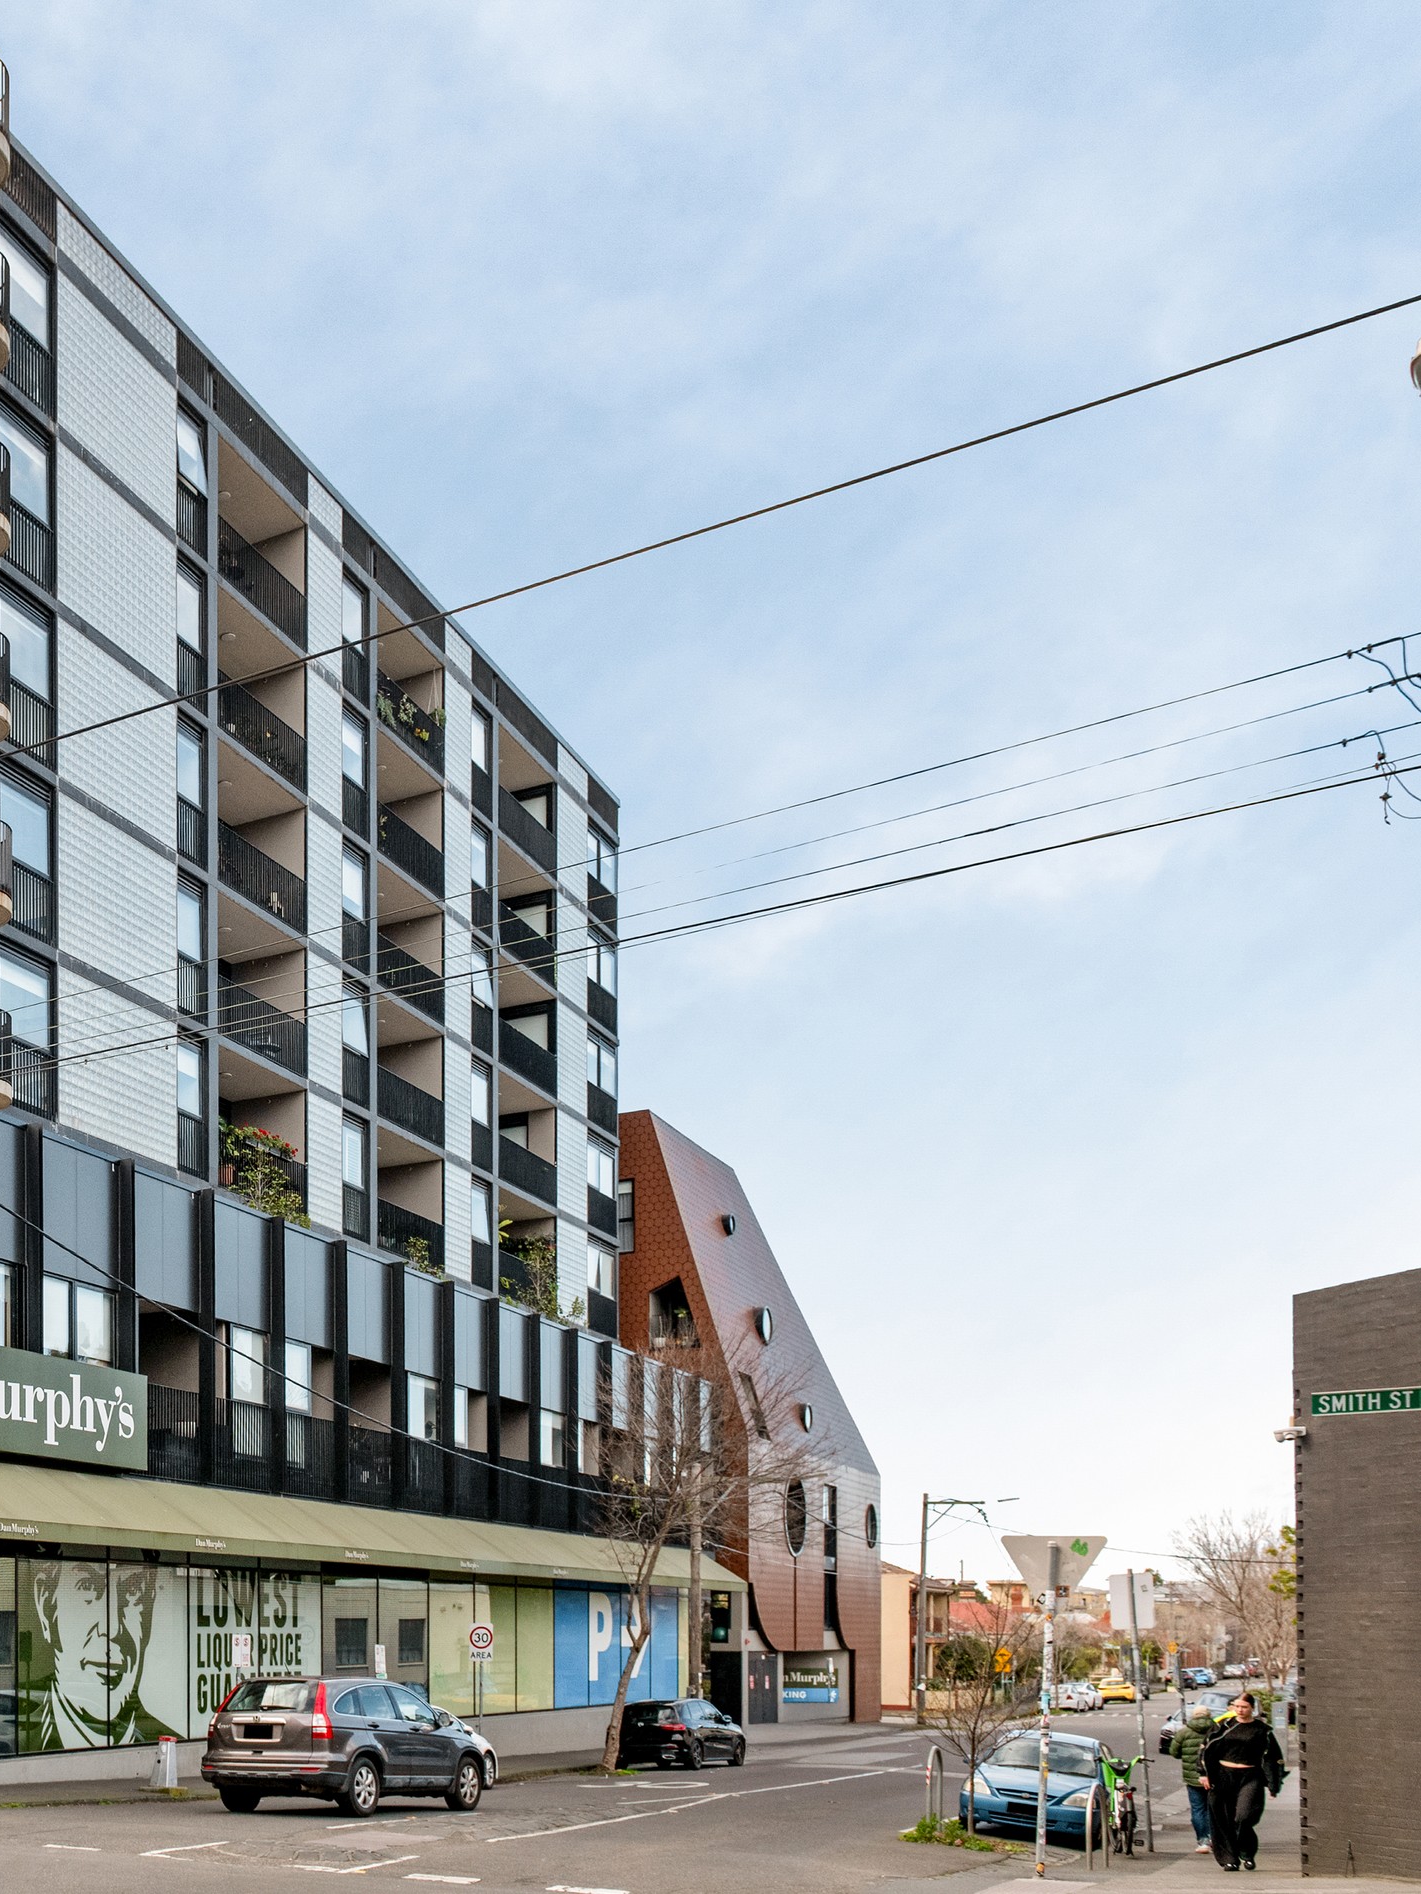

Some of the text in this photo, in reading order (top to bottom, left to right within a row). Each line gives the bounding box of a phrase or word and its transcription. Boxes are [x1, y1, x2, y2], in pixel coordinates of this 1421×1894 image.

[1318, 1390, 1414, 1413] SMITH ST
[12, 1523, 39, 1536] Murphy's
[195, 1538, 226, 1550] Dan Murphy's
[197, 1569, 302, 1628] LOWEST
[474, 1632, 489, 1643] 30
[589, 1592, 613, 1681] P
[197, 1633, 255, 1671] LIQUR
[260, 1633, 302, 1666] PRICE
[470, 1651, 492, 1659] AREA
[789, 1671, 836, 1685] Murphys
[782, 1690, 807, 1699] KING
